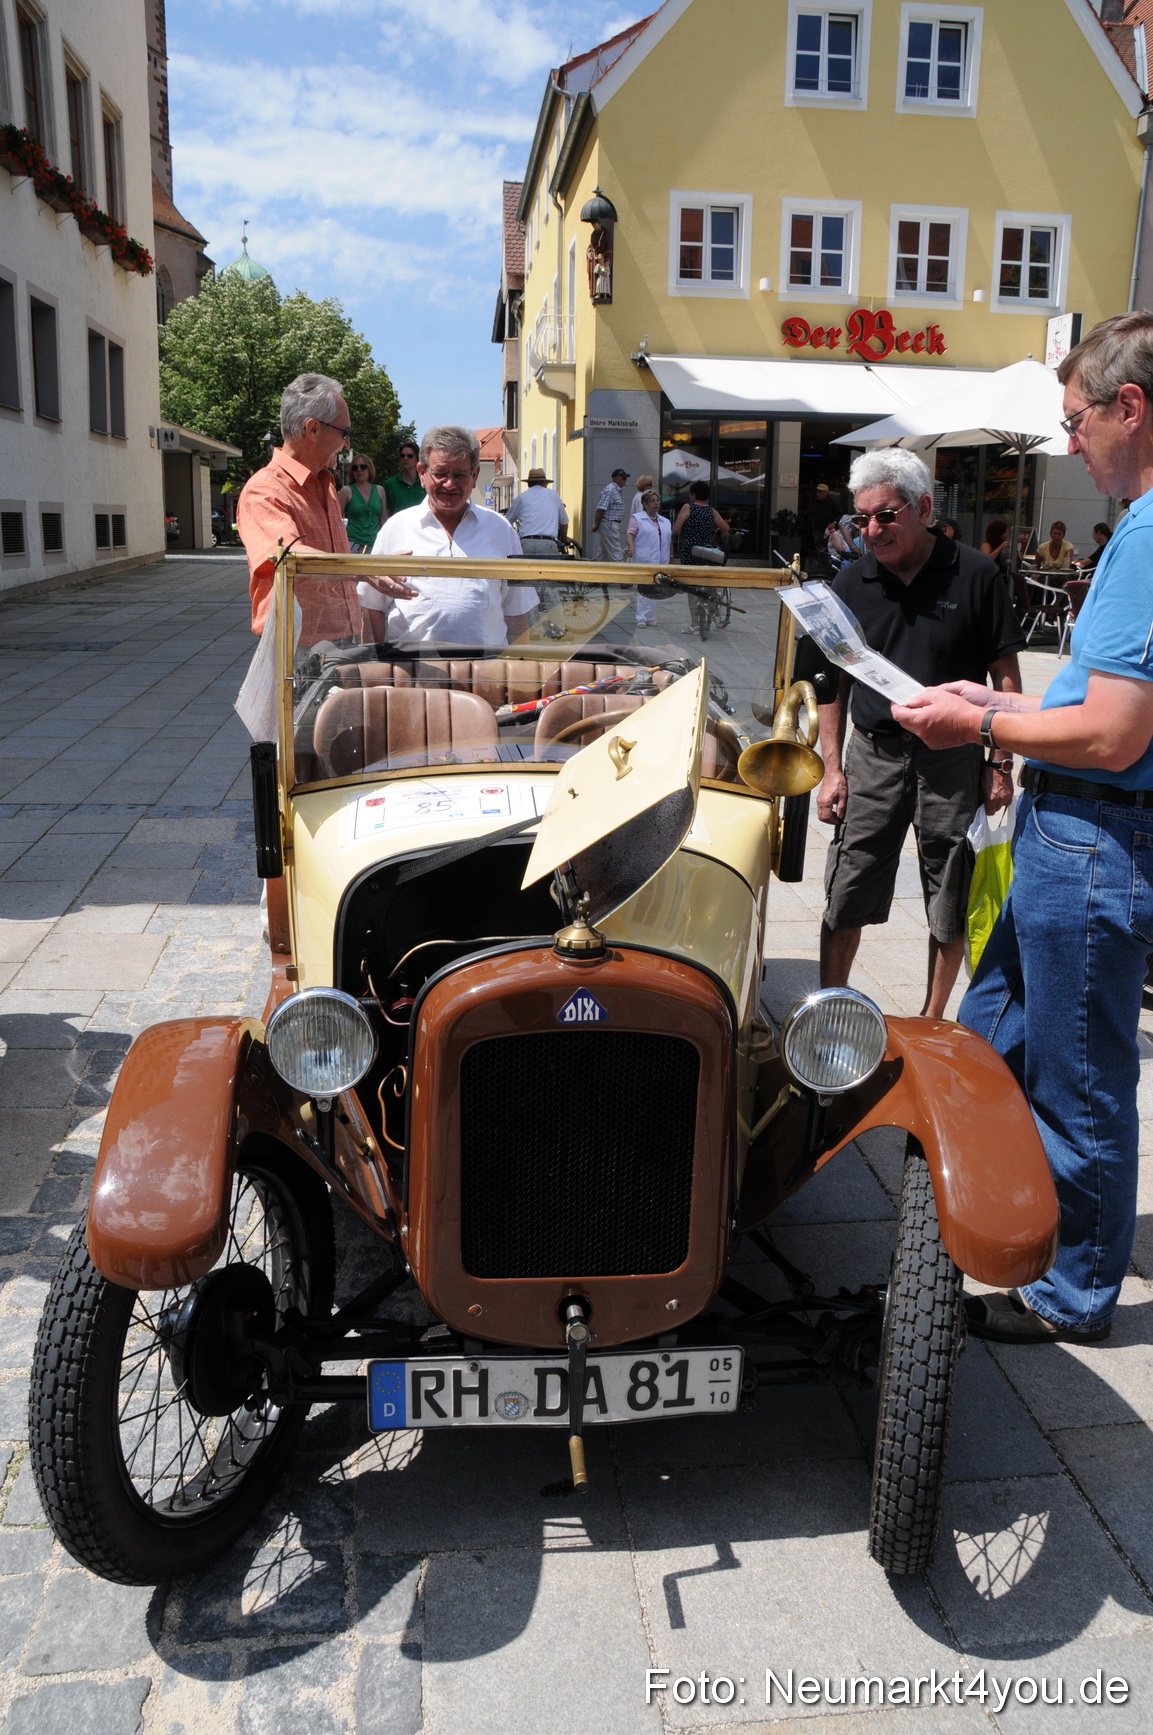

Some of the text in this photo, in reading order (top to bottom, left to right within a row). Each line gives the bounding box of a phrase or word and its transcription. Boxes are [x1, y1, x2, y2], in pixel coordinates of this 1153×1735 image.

[781, 308, 948, 362] Der Beck
[608, 419, 638, 427] Marktstraße
[415, 800, 452, 814] 85
[563, 998, 600, 1022] DIXI
[709, 1357, 733, 1372] 05
[411, 1367, 489, 1419] RH
[626, 1359, 695, 1412] 81
[709, 1391, 731, 1405] 10
[383, 1402, 396, 1417] D
